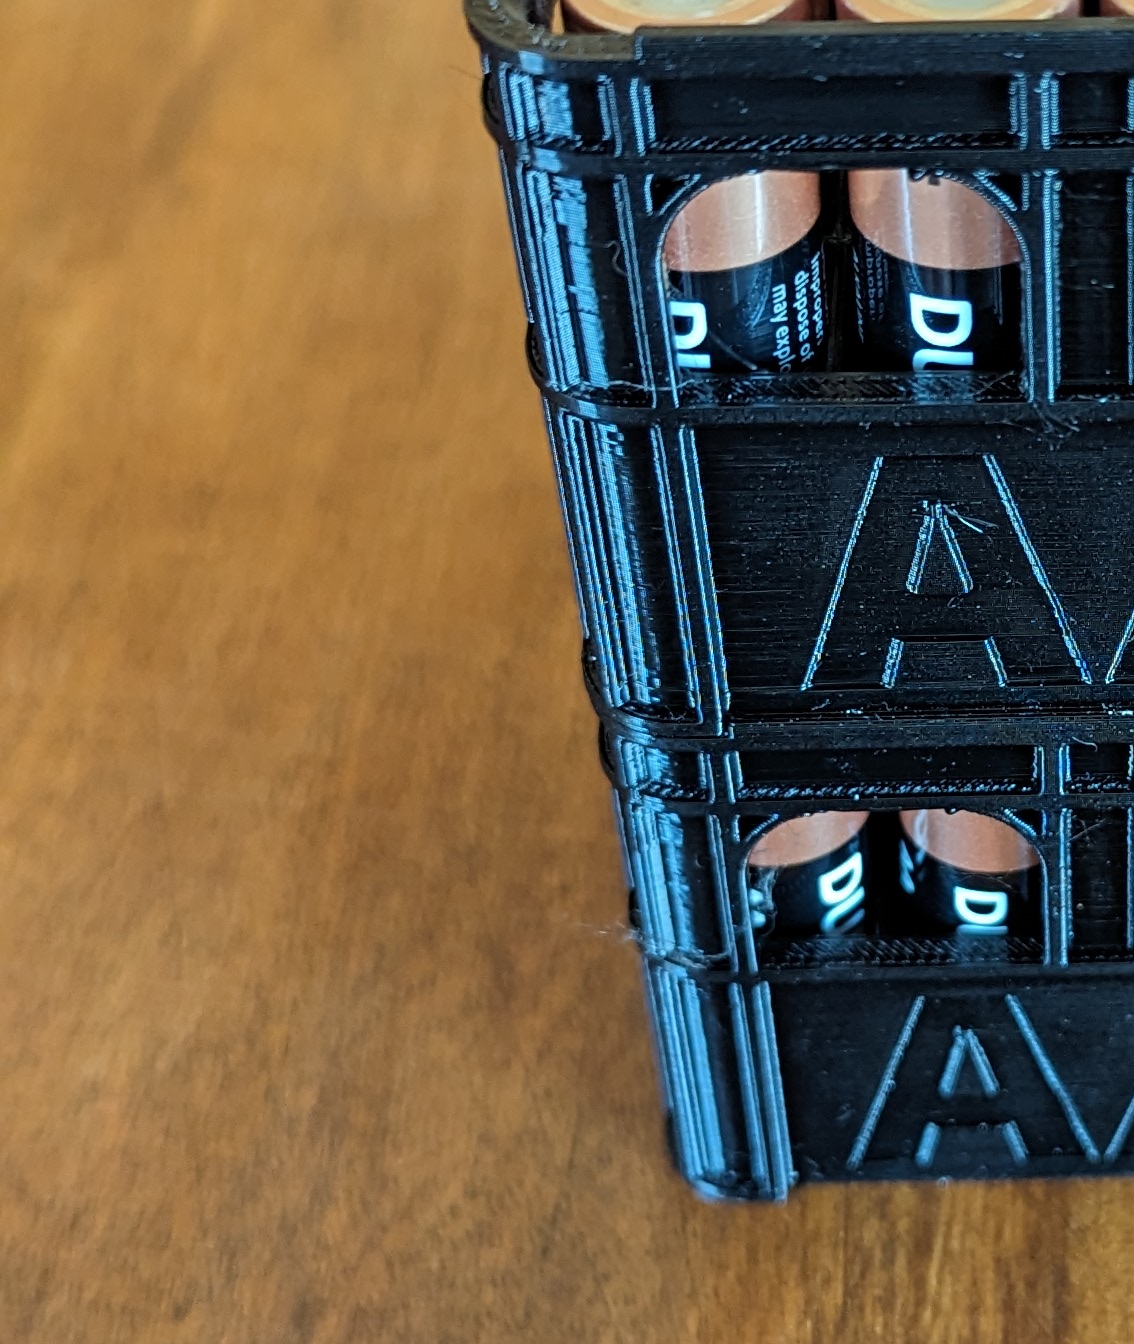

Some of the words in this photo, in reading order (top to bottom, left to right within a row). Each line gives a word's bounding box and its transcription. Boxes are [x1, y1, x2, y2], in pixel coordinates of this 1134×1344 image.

[769, 282, 789, 324] may
[792, 269, 811, 343] dispose
[669, 300, 712, 370] D
[799, 342, 816, 363] of
[954, 885, 1009, 936] D
